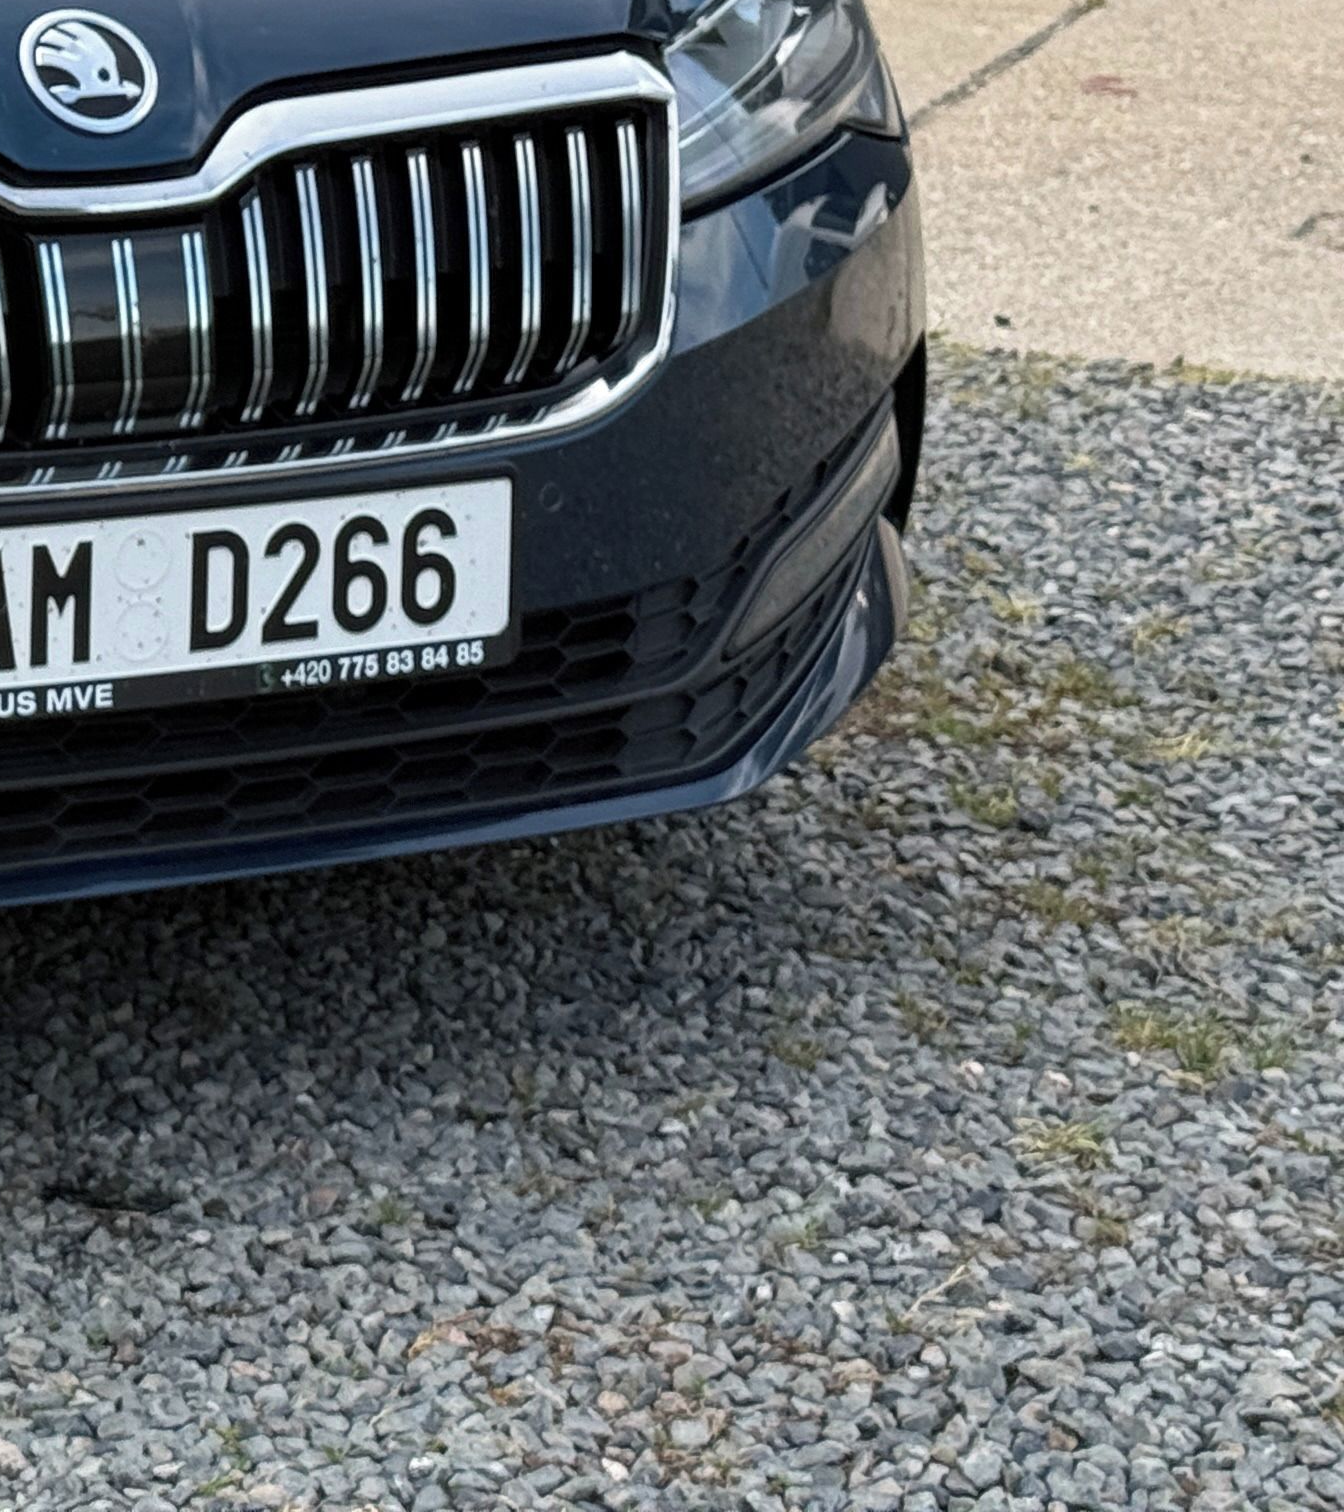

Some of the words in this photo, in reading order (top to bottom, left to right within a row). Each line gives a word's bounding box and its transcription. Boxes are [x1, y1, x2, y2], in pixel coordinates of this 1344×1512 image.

[189, 506, 457, 652] D266
[281, 659, 332, 687] +420
[338, 653, 379, 679] 775
[386, 649, 413, 674] 83
[421, 644, 449, 670] 84
[456, 640, 484, 665] 85
[46, 683, 113, 713] MVE
